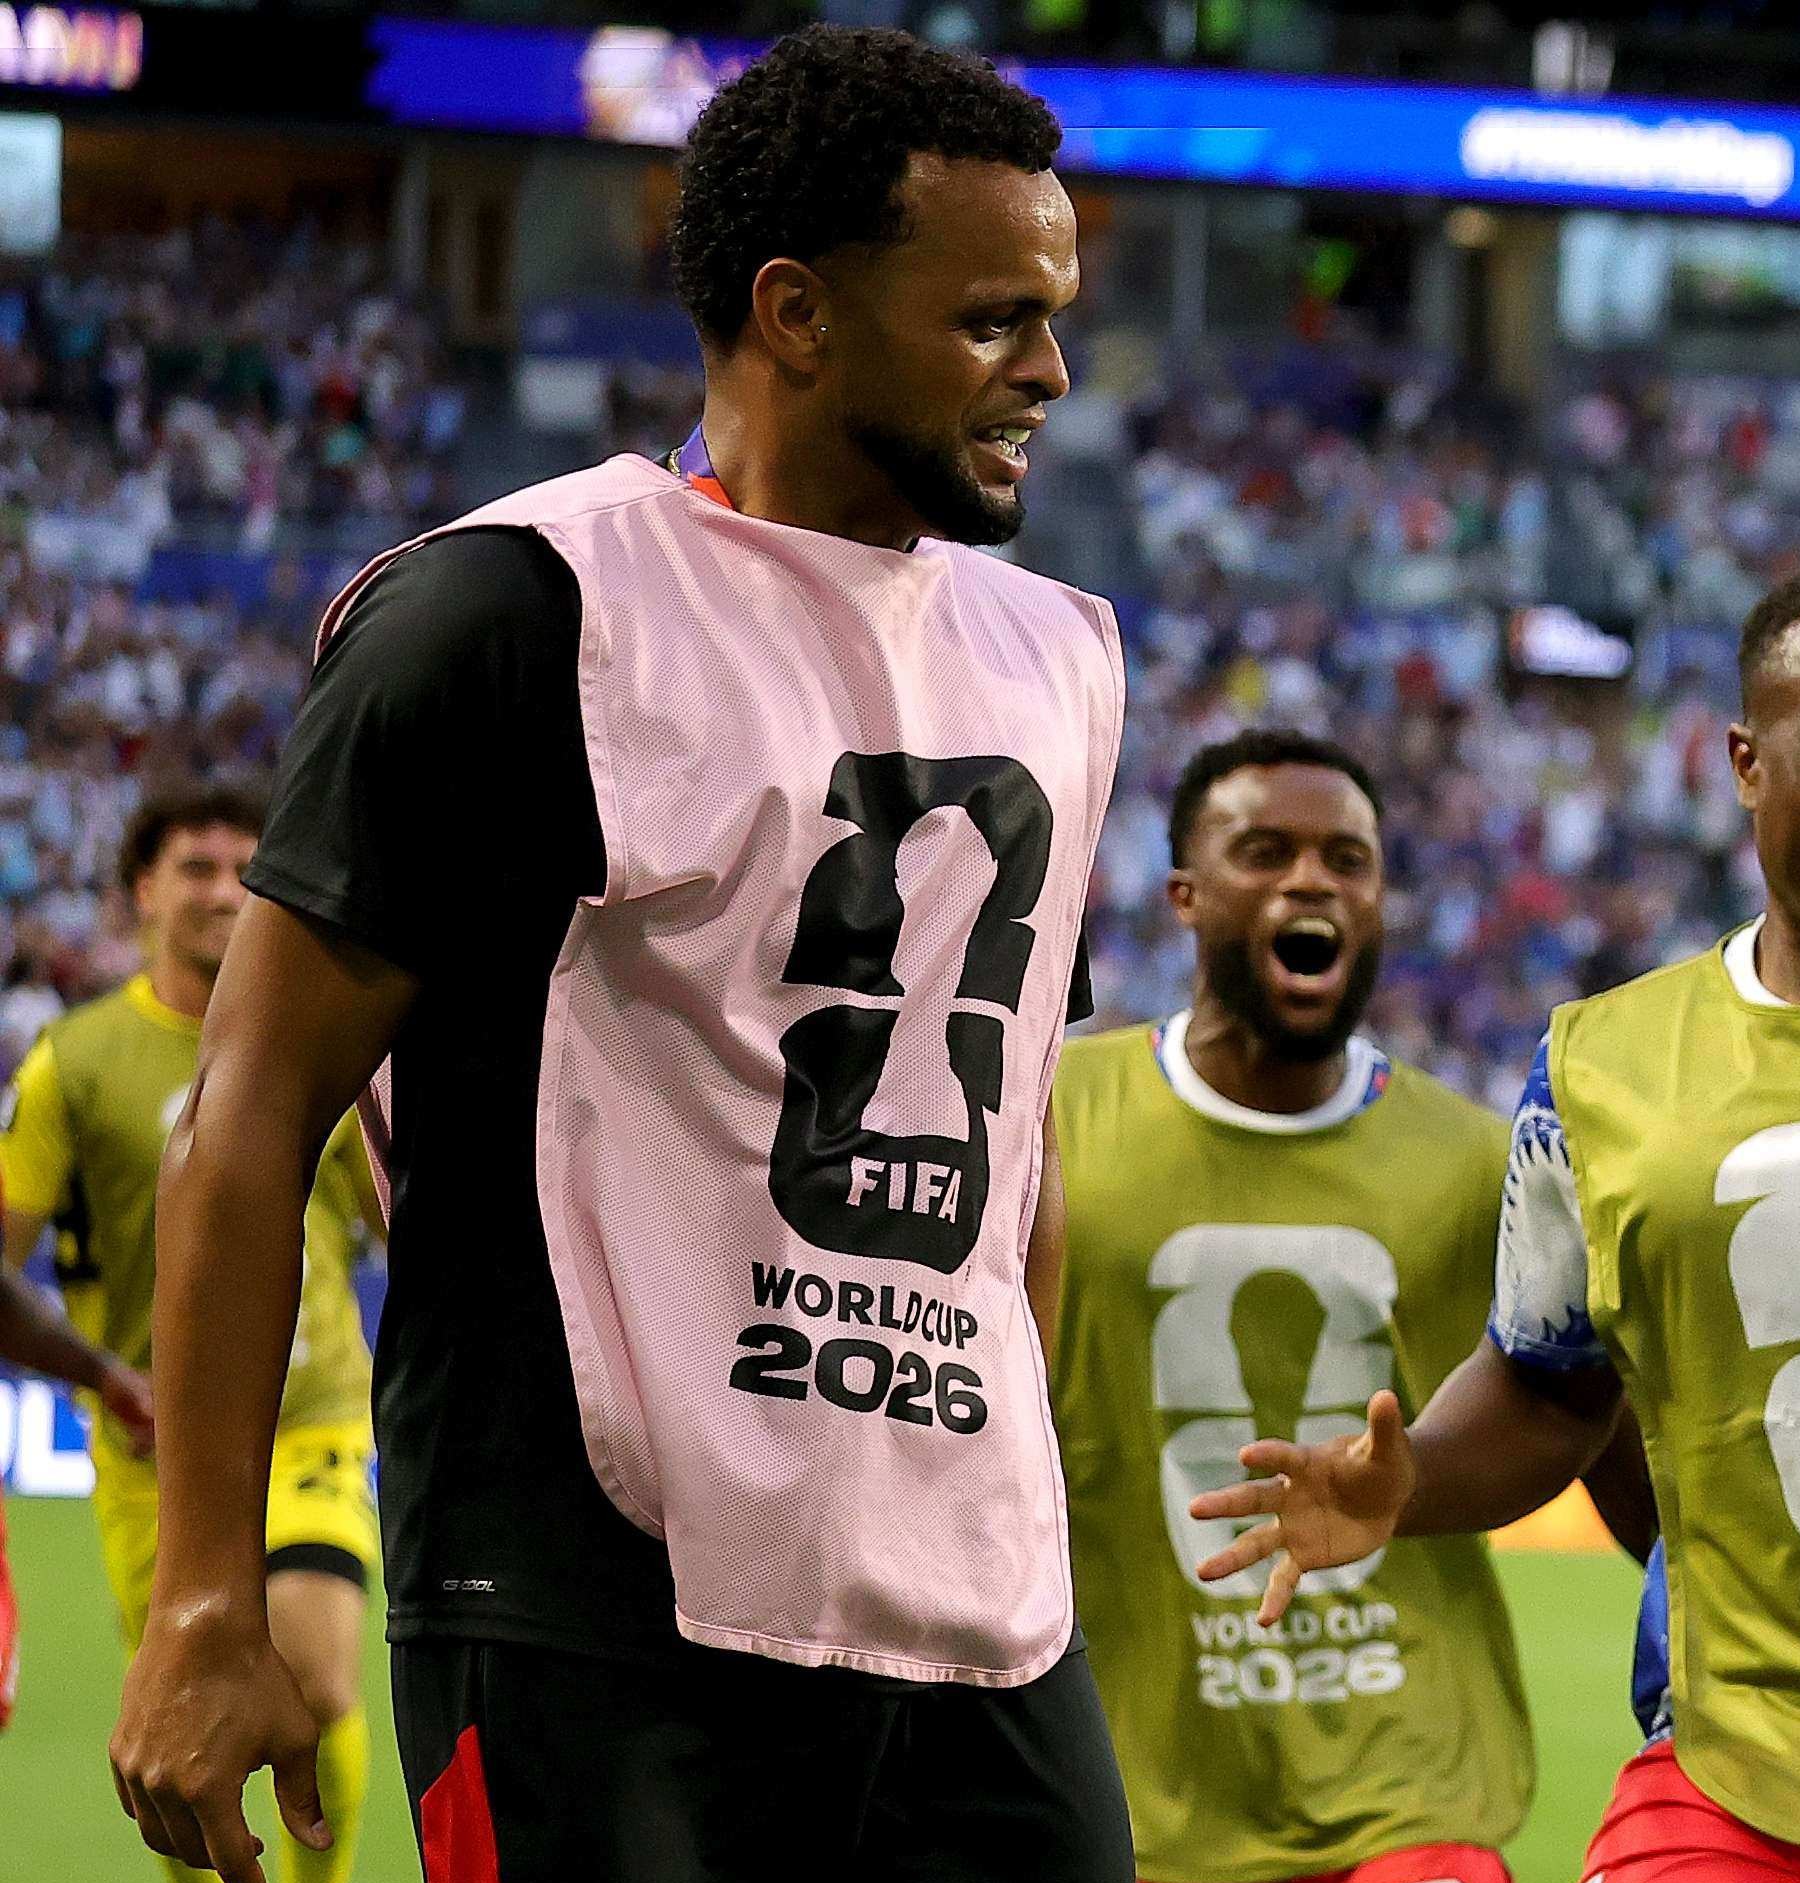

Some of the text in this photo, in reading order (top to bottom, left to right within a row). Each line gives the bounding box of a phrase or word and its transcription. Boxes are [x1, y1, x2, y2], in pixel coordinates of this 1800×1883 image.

[846, 1156, 964, 1224] FIFA
[729, 1323, 988, 1435] 2026
[1197, 1641, 1407, 1709] 2026
